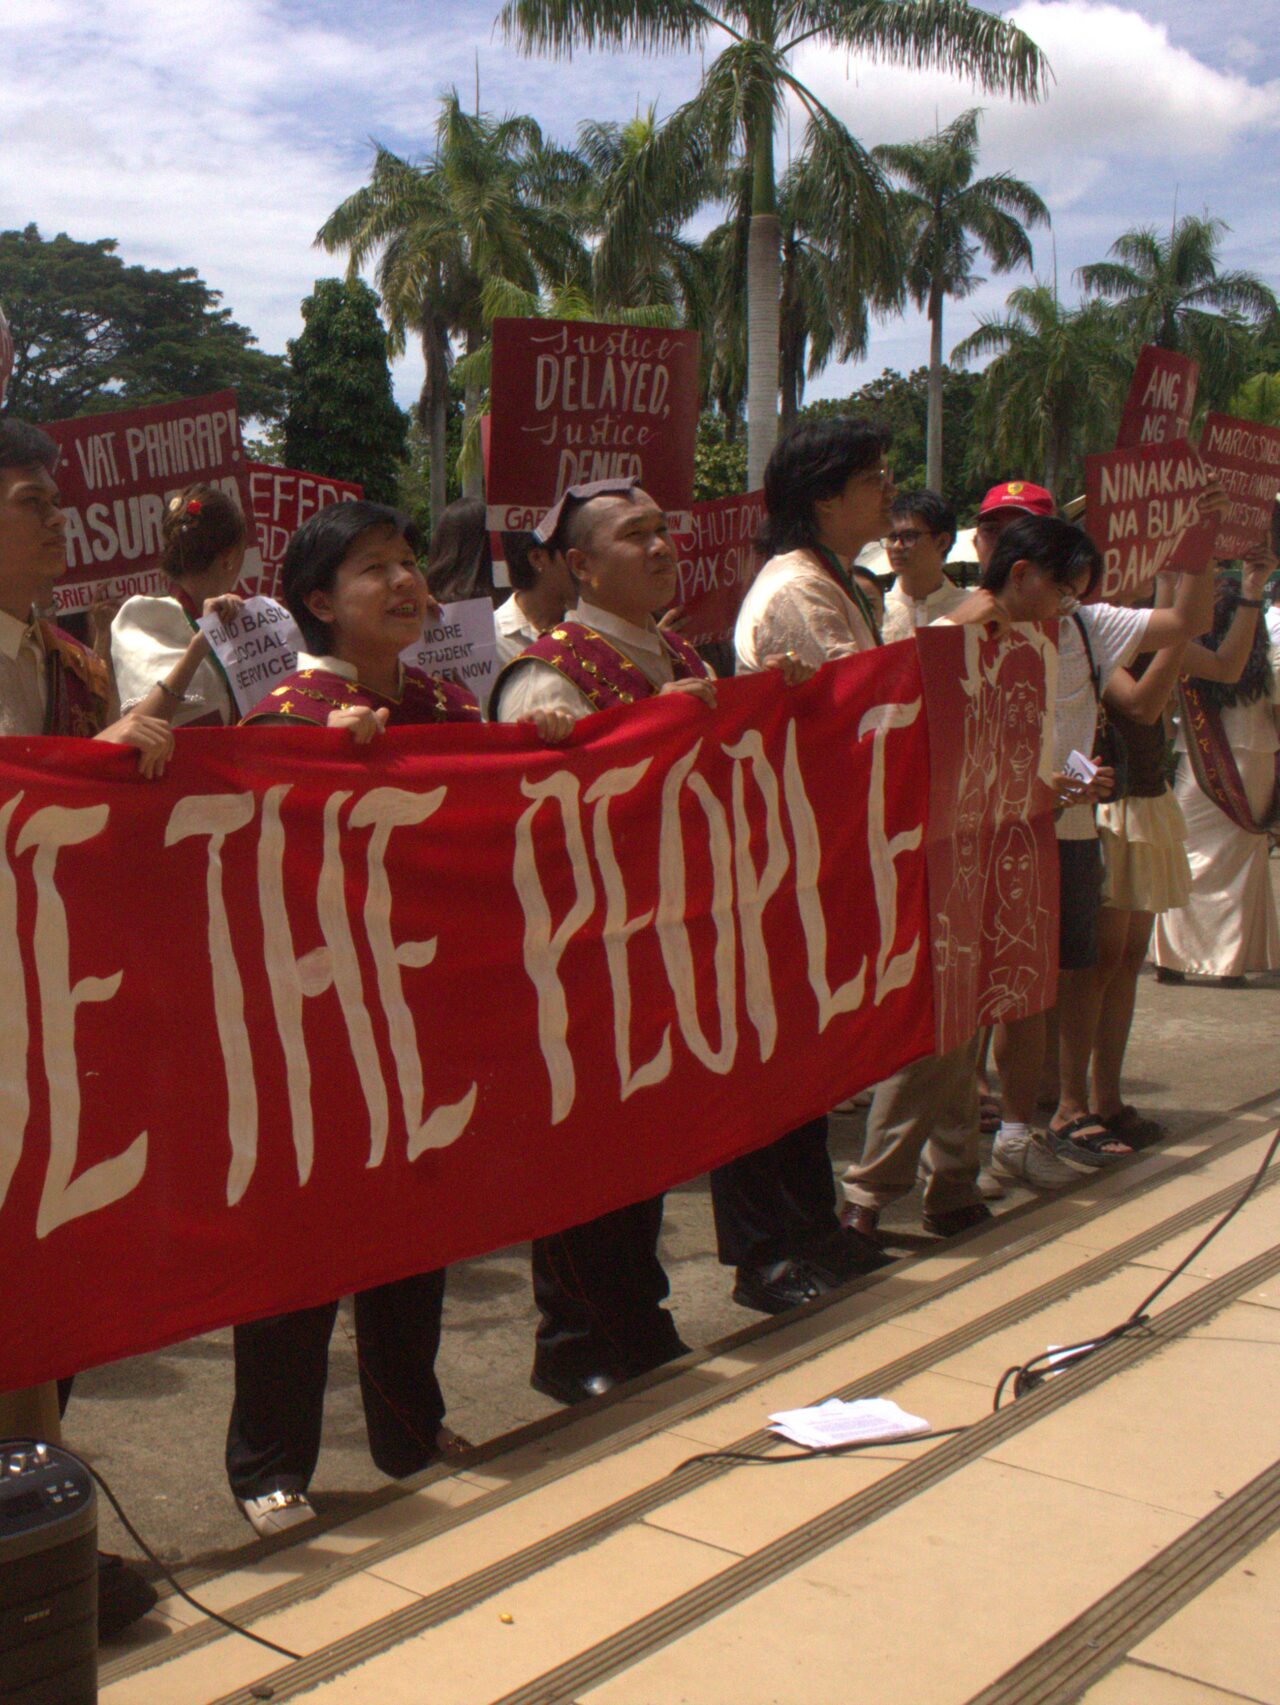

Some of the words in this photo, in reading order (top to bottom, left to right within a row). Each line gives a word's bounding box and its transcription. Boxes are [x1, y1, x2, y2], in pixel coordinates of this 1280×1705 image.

[530, 326, 685, 357] Justice
[535, 353, 671, 420] DELAYED,
[1141, 365, 1180, 411] ANG
[125, 409, 240, 482] PAHIRAP!
[521, 413, 652, 446] Justice
[1140, 414, 1167, 444] NG
[1100, 455, 1208, 506] NINAKAW
[1108, 508, 1138, 542] NA
[677, 552, 719, 605] PAX
[241, 606, 291, 633] BASIC
[423, 623, 462, 644] MORE
[417, 642, 474, 666] STUDENT
[461, 660, 493, 678] NOW
[165, 786, 478, 1207] THE
[513, 695, 923, 1124] PEOPLE
